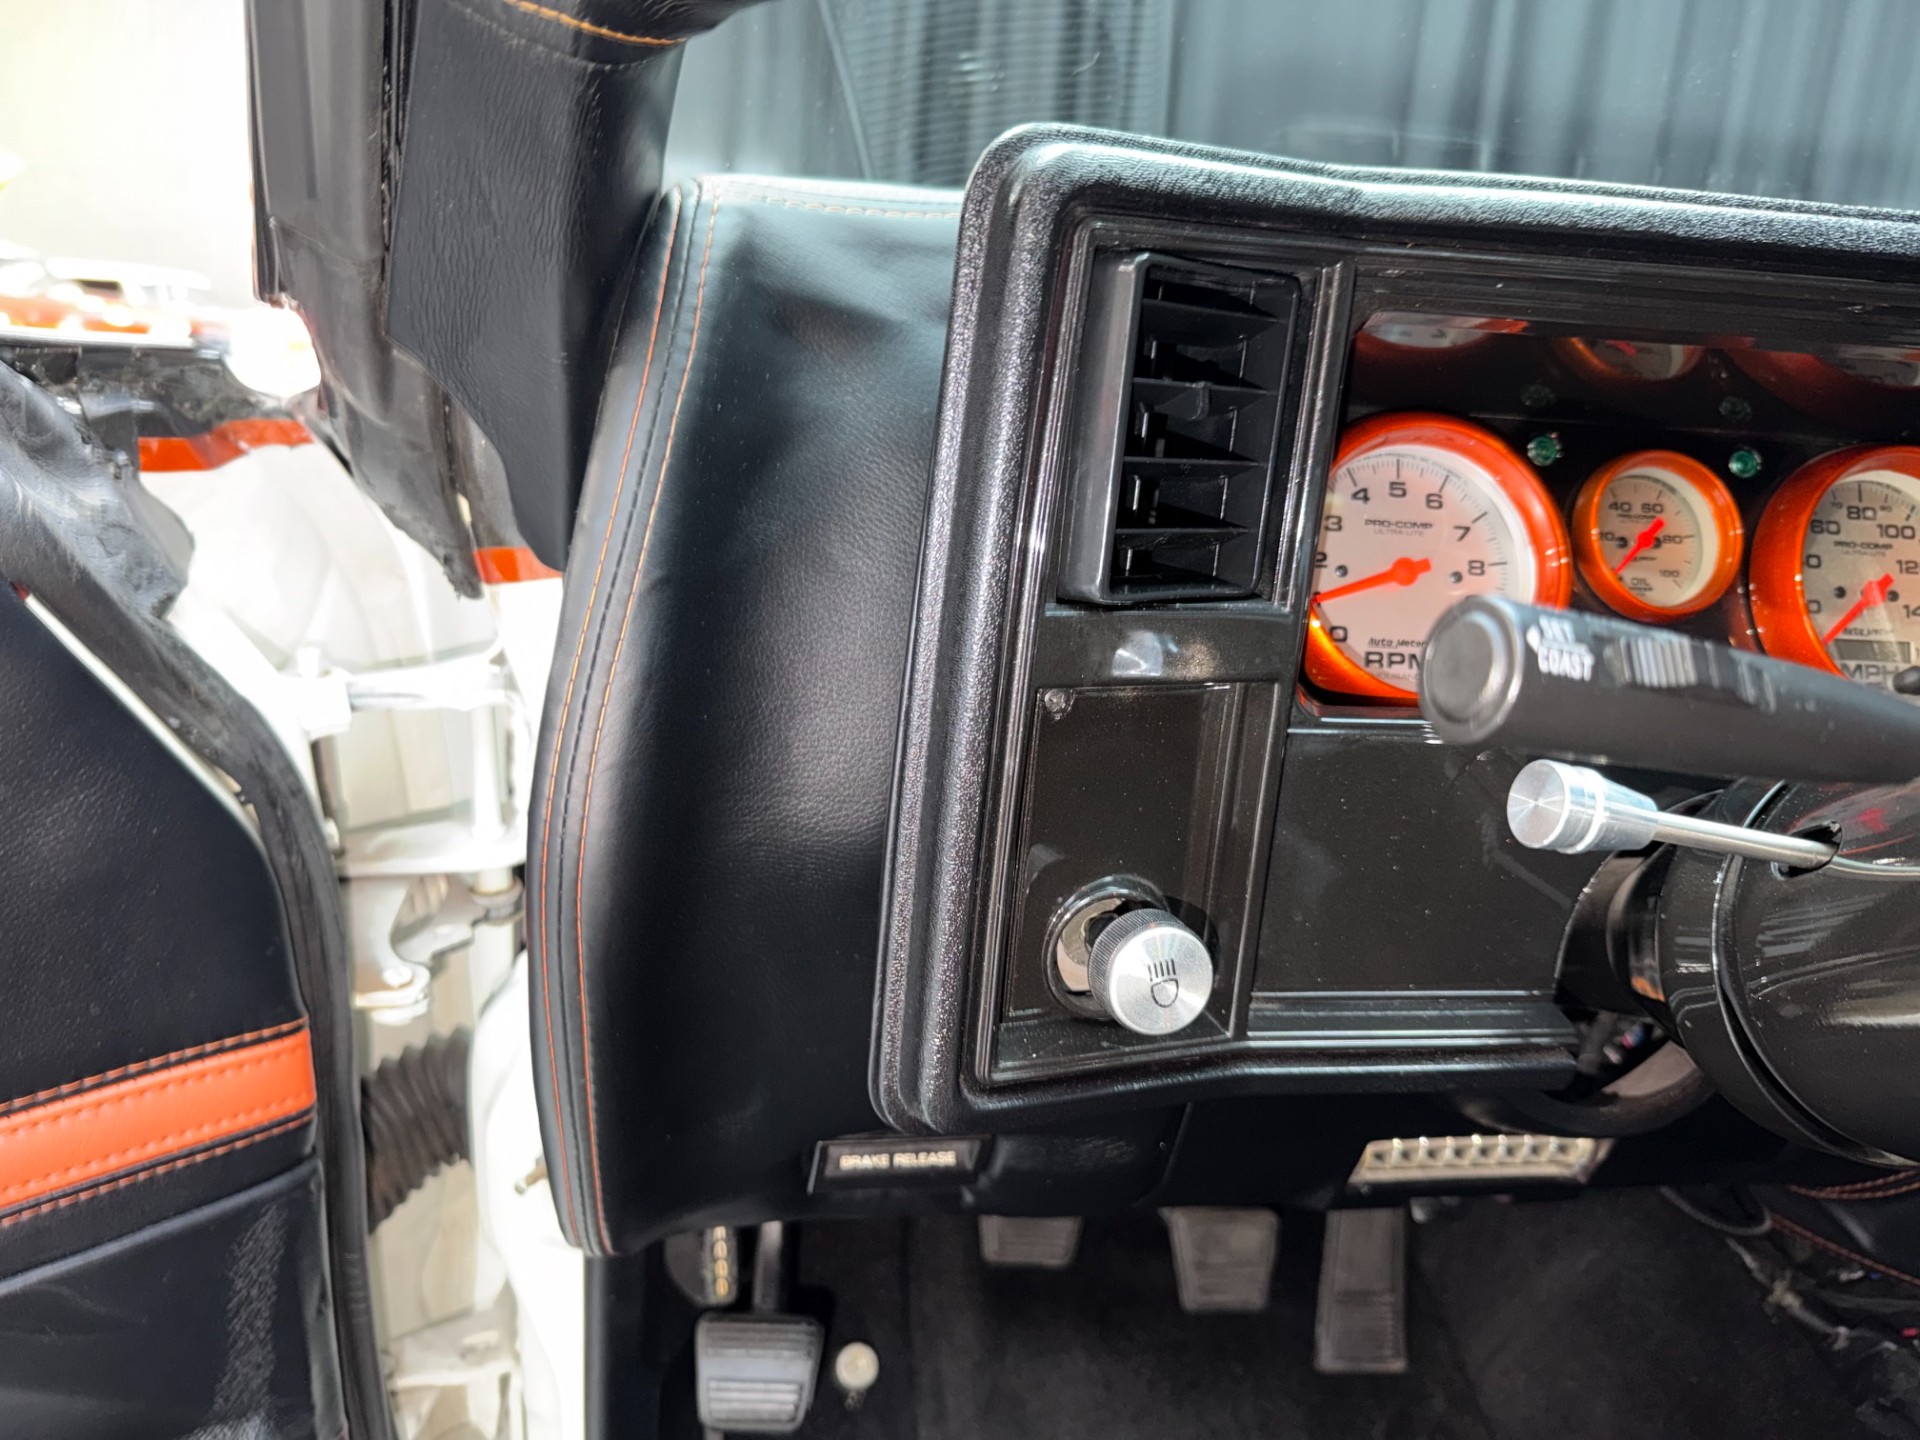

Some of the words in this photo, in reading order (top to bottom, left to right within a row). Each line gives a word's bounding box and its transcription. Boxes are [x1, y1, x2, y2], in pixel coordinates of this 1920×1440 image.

[1351, 488, 1370, 504] 4
[1389, 482, 1407, 498] 5
[1426, 494, 1443, 509] 6
[1608, 502, 1632, 513] 40
[1847, 505, 1877, 520] 80
[1324, 515, 1342, 532] 3
[1365, 519, 1433, 529] PRO-COMP
[1810, 519, 1841, 535] 60
[1454, 526, 1471, 542] 7
[1876, 524, 1916, 539] 100
[1315, 552, 1328, 568] 2
[1804, 554, 1822, 569] 0
[1896, 560, 1920, 575] 12
[1468, 560, 1486, 576] 8
[1806, 599, 1822, 614] 0
[1902, 604, 1920, 619] 14
[1329, 625, 1348, 642] 0
[839, 1153, 890, 1170] BRAKE
[893, 1151, 957, 1167] RELEASE
